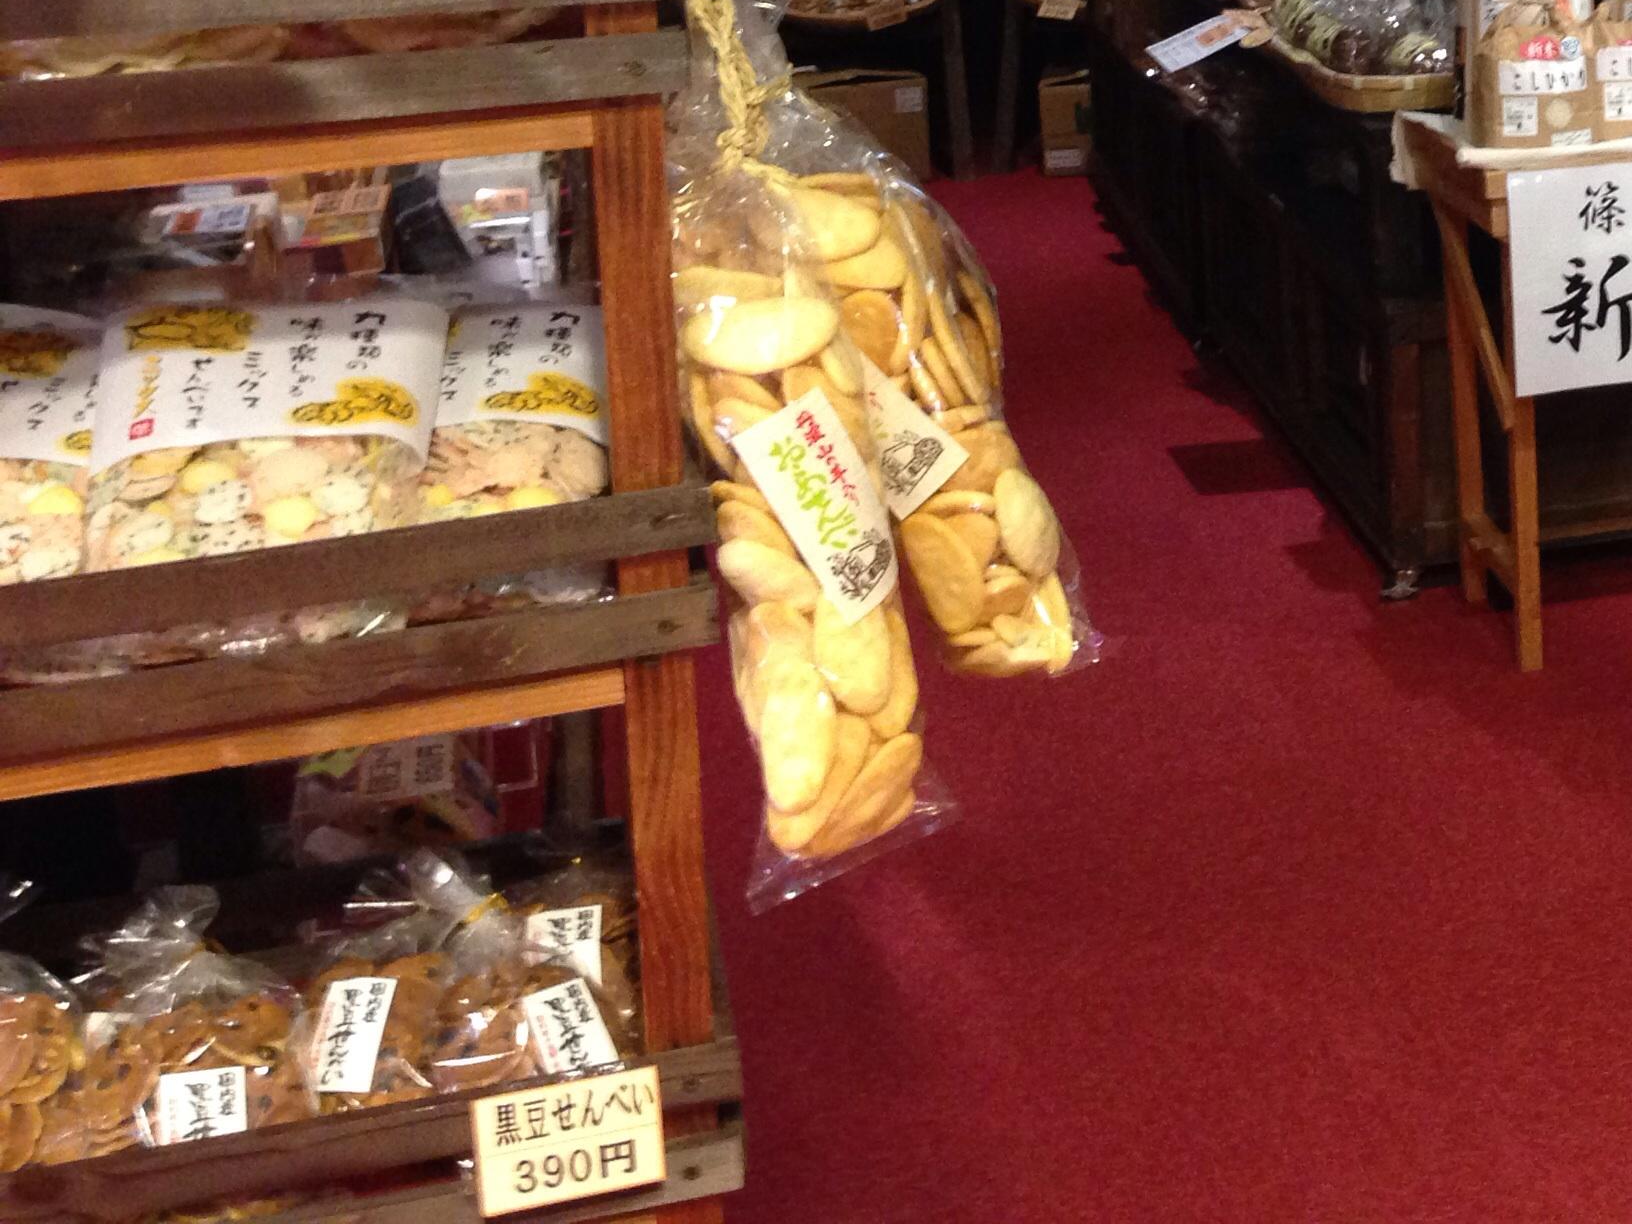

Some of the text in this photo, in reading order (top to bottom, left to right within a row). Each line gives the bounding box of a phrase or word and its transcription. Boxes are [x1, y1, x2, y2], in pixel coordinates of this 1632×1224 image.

[1511, 69, 1586, 92] こしひかり
[495, 1082, 655, 1147] 黒豆せんべい
[515, 1138, 638, 1194] 390円
